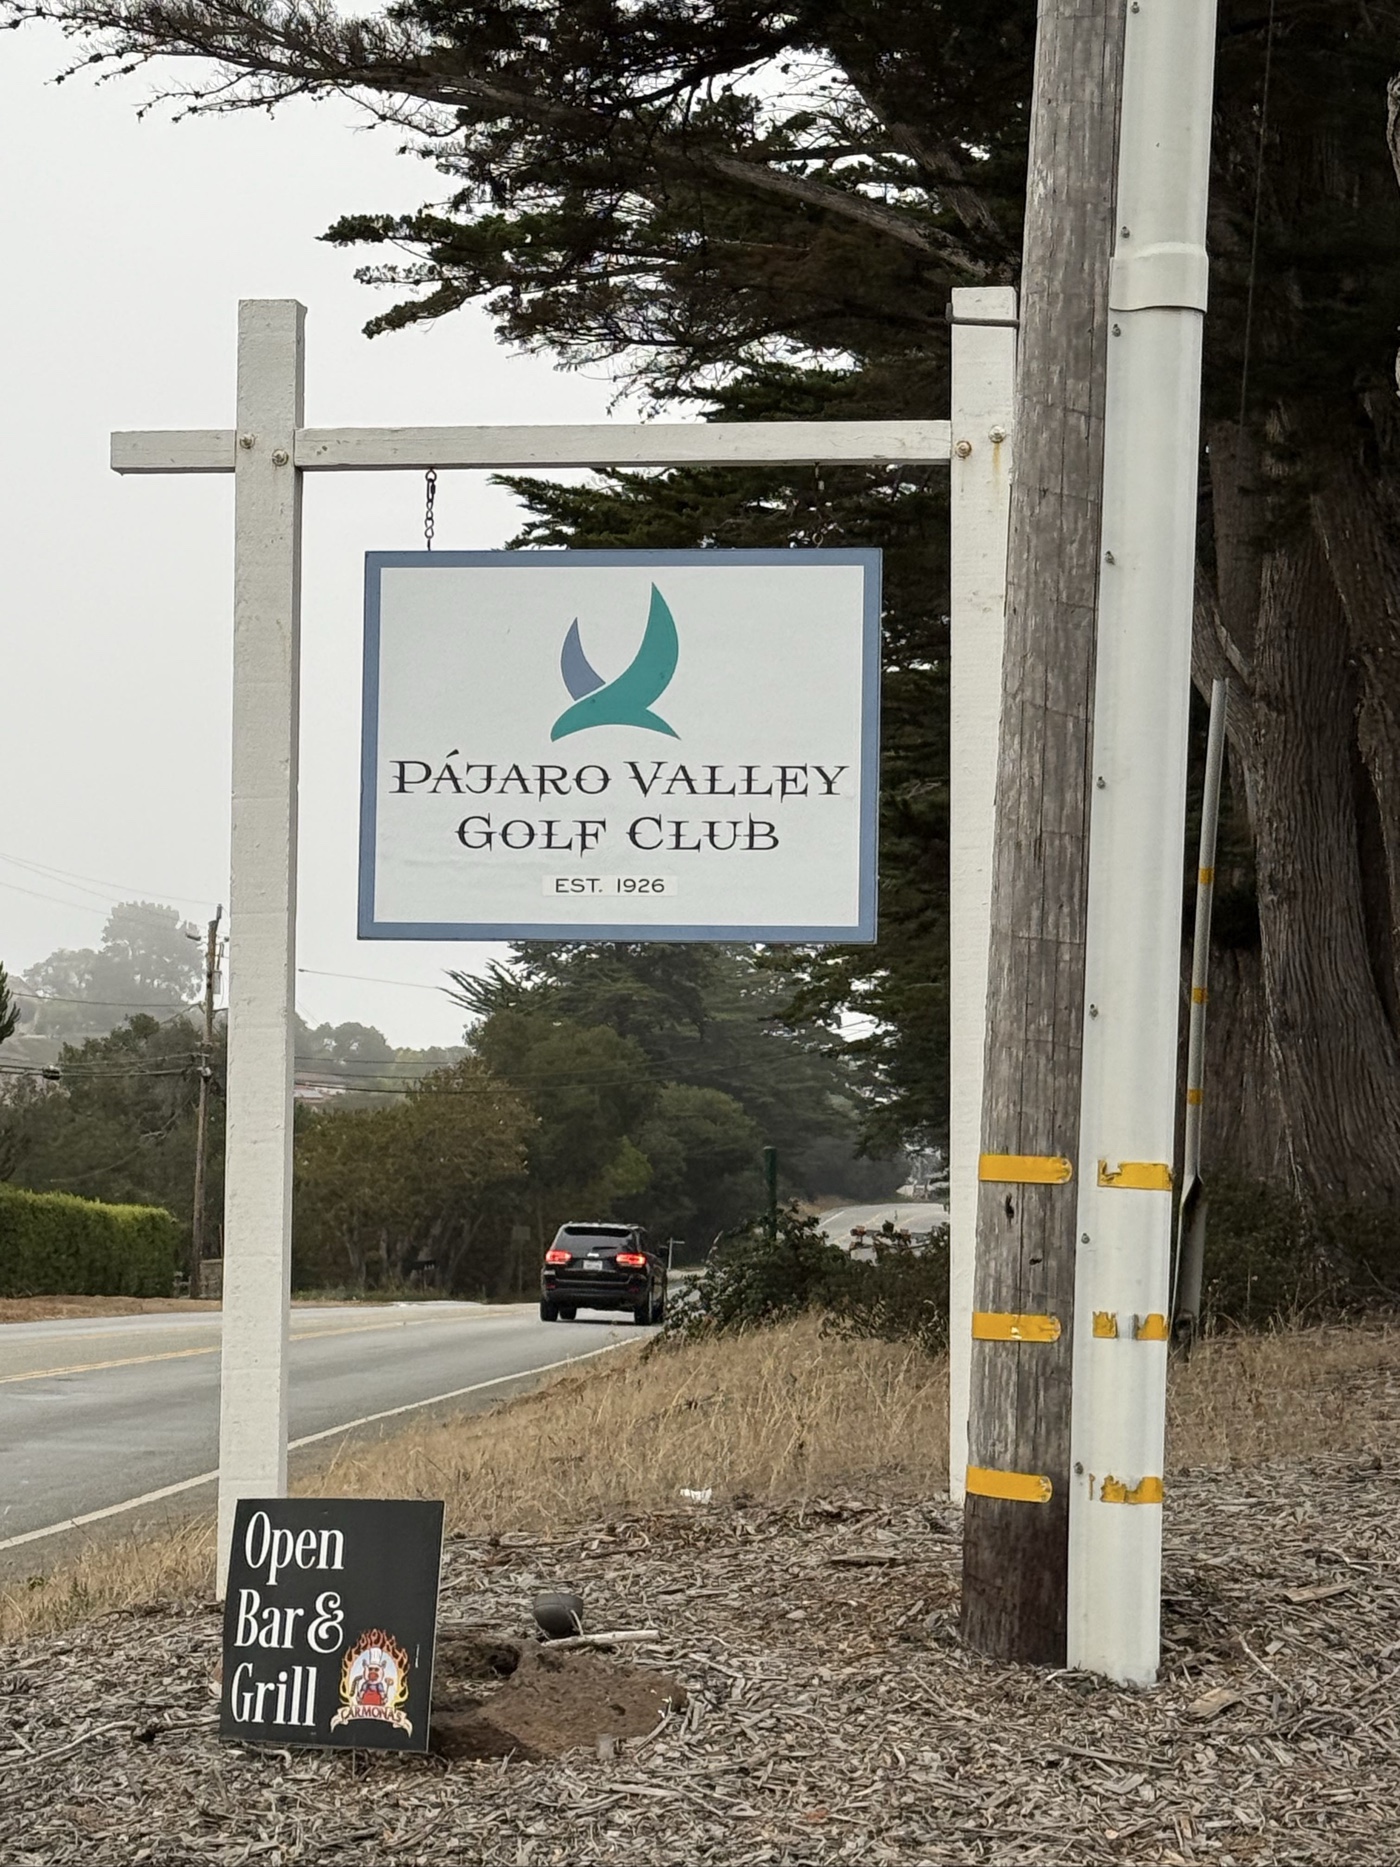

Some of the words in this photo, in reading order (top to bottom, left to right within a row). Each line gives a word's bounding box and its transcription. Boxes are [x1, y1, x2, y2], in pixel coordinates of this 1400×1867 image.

[389, 748, 612, 802] PÁJARO
[623, 761, 850, 803] VALLEY
[455, 813, 607, 857] GOLF
[626, 813, 779, 852] CLUB
[555, 878, 603, 893] EST.
[616, 878, 665, 893] 1926
[245, 1511, 345, 1586] Open
[233, 1588, 304, 1649] Bar
[306, 1591, 345, 1654] &
[231, 1662, 317, 1727] Grill
